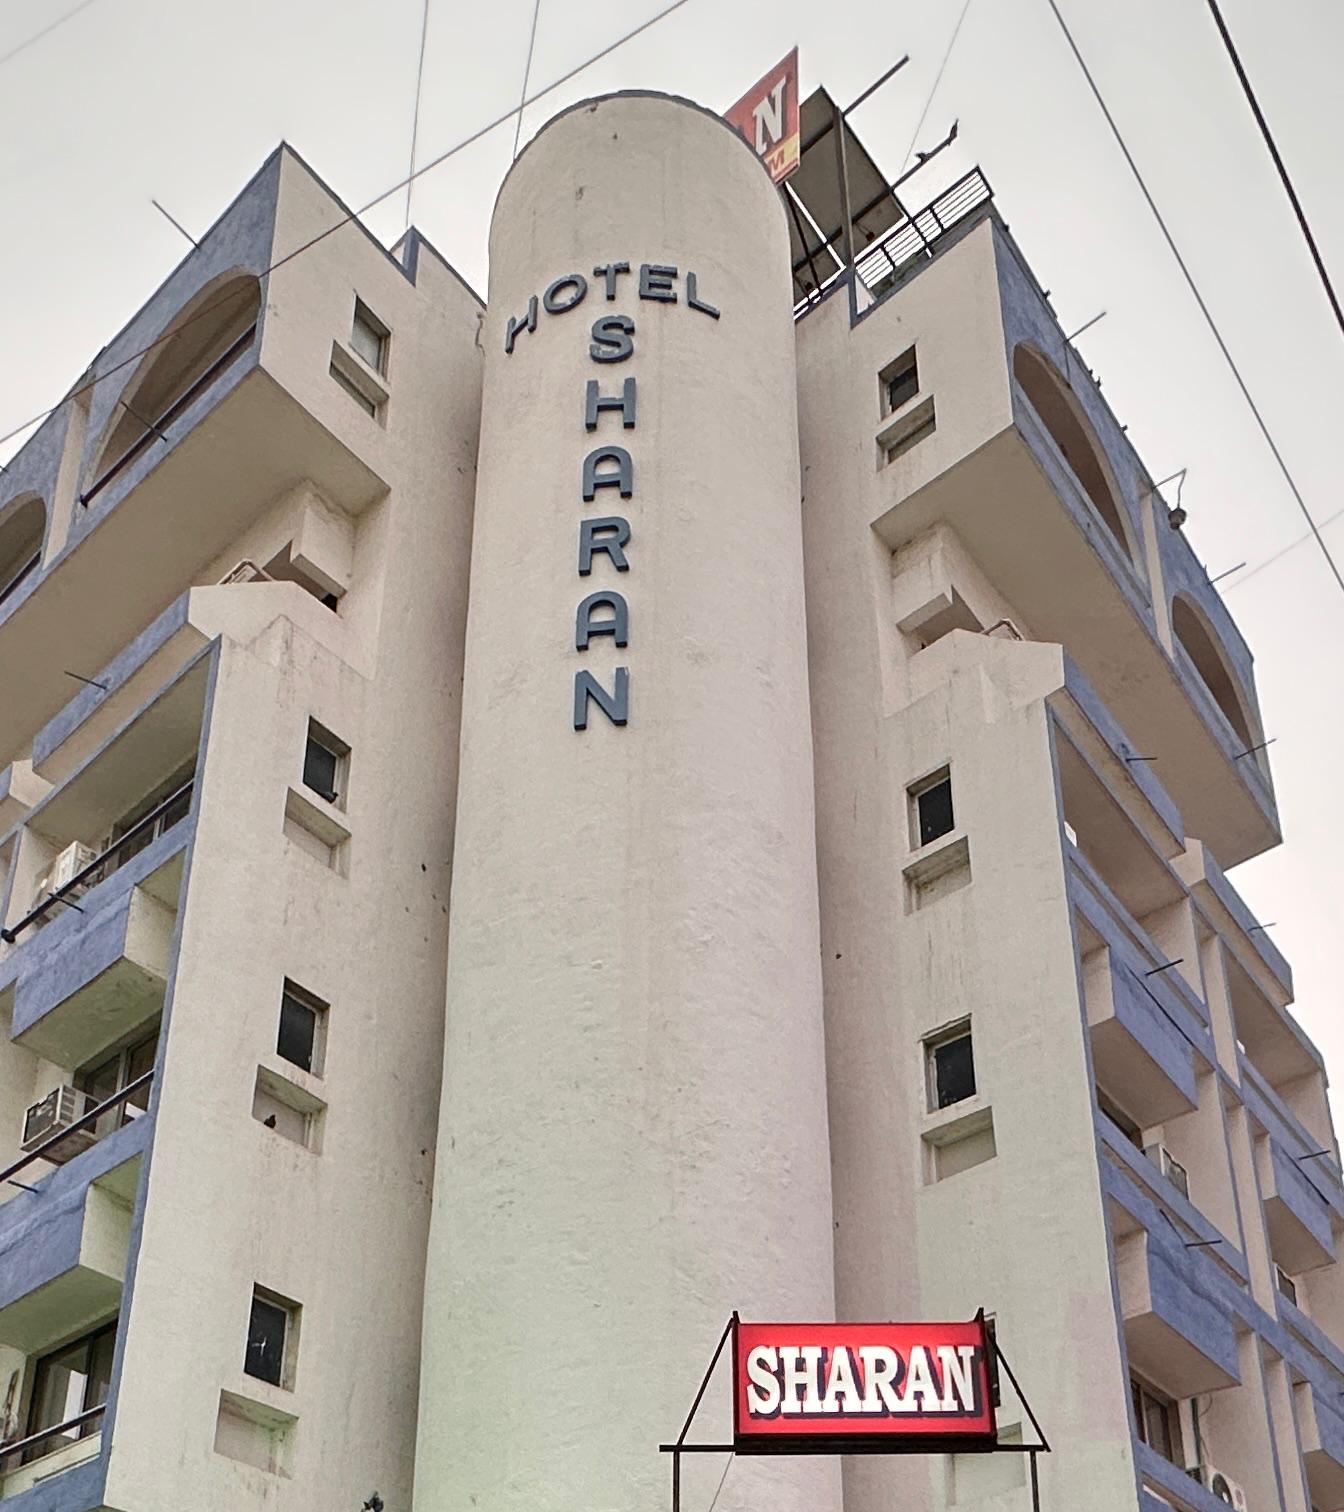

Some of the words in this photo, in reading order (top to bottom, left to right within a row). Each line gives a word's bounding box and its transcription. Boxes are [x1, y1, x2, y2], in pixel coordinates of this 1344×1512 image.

[504, 262, 721, 354] HOTEL
[573, 314, 637, 731] SHARAN
[746, 1344, 983, 1418] SHARAN
